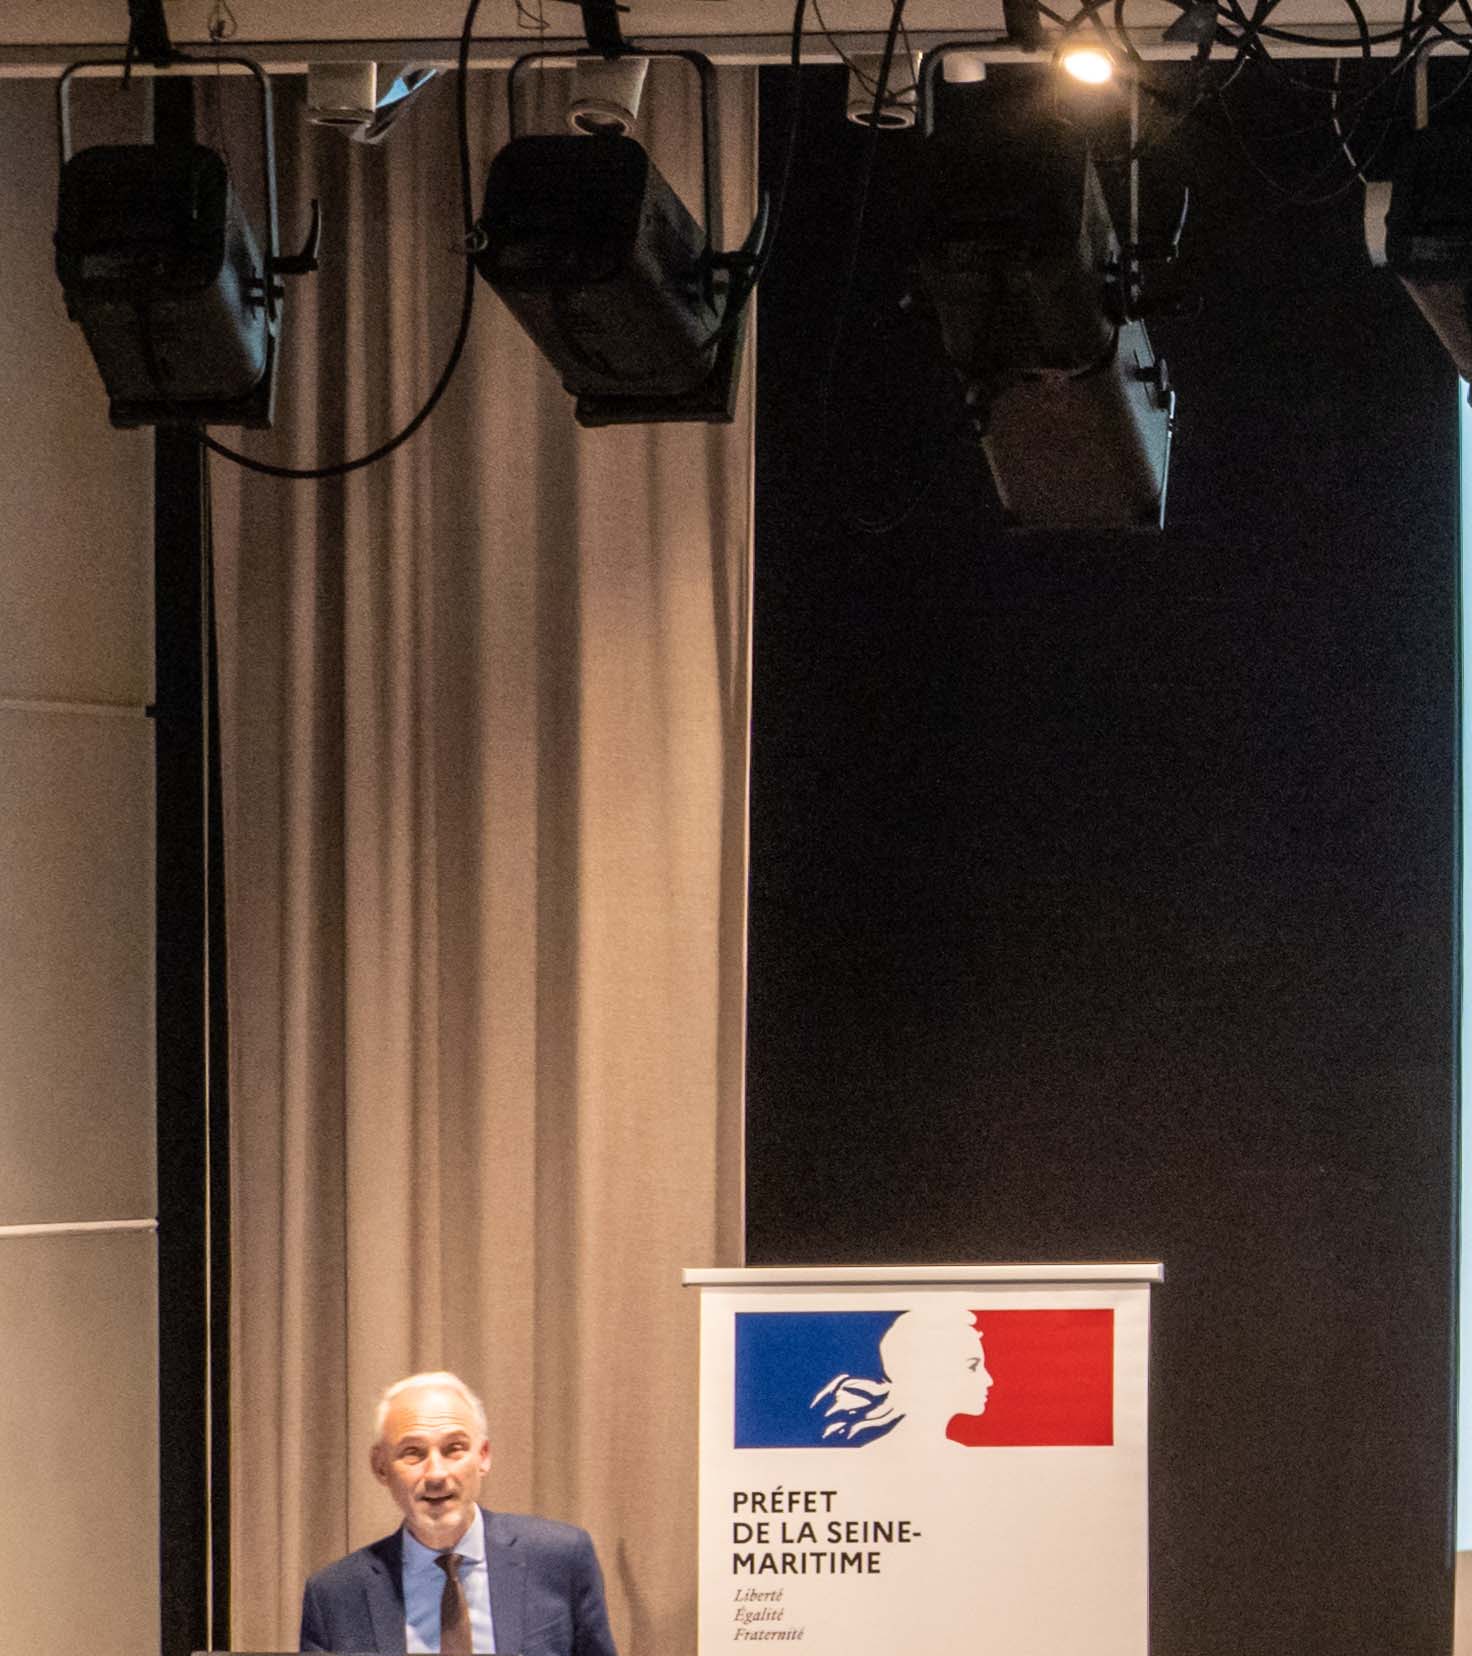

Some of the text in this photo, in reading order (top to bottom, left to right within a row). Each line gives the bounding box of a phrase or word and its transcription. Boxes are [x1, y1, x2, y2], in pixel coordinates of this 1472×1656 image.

[733, 1485, 838, 1514] PRÉFET
[733, 1520, 922, 1544] DE LA SEINE-
[733, 1551, 882, 1575] MARITIME
[733, 1588, 783, 1603] Liberté
[733, 1606, 784, 1624] Égalité
[733, 1627, 804, 1641] Fraternité
